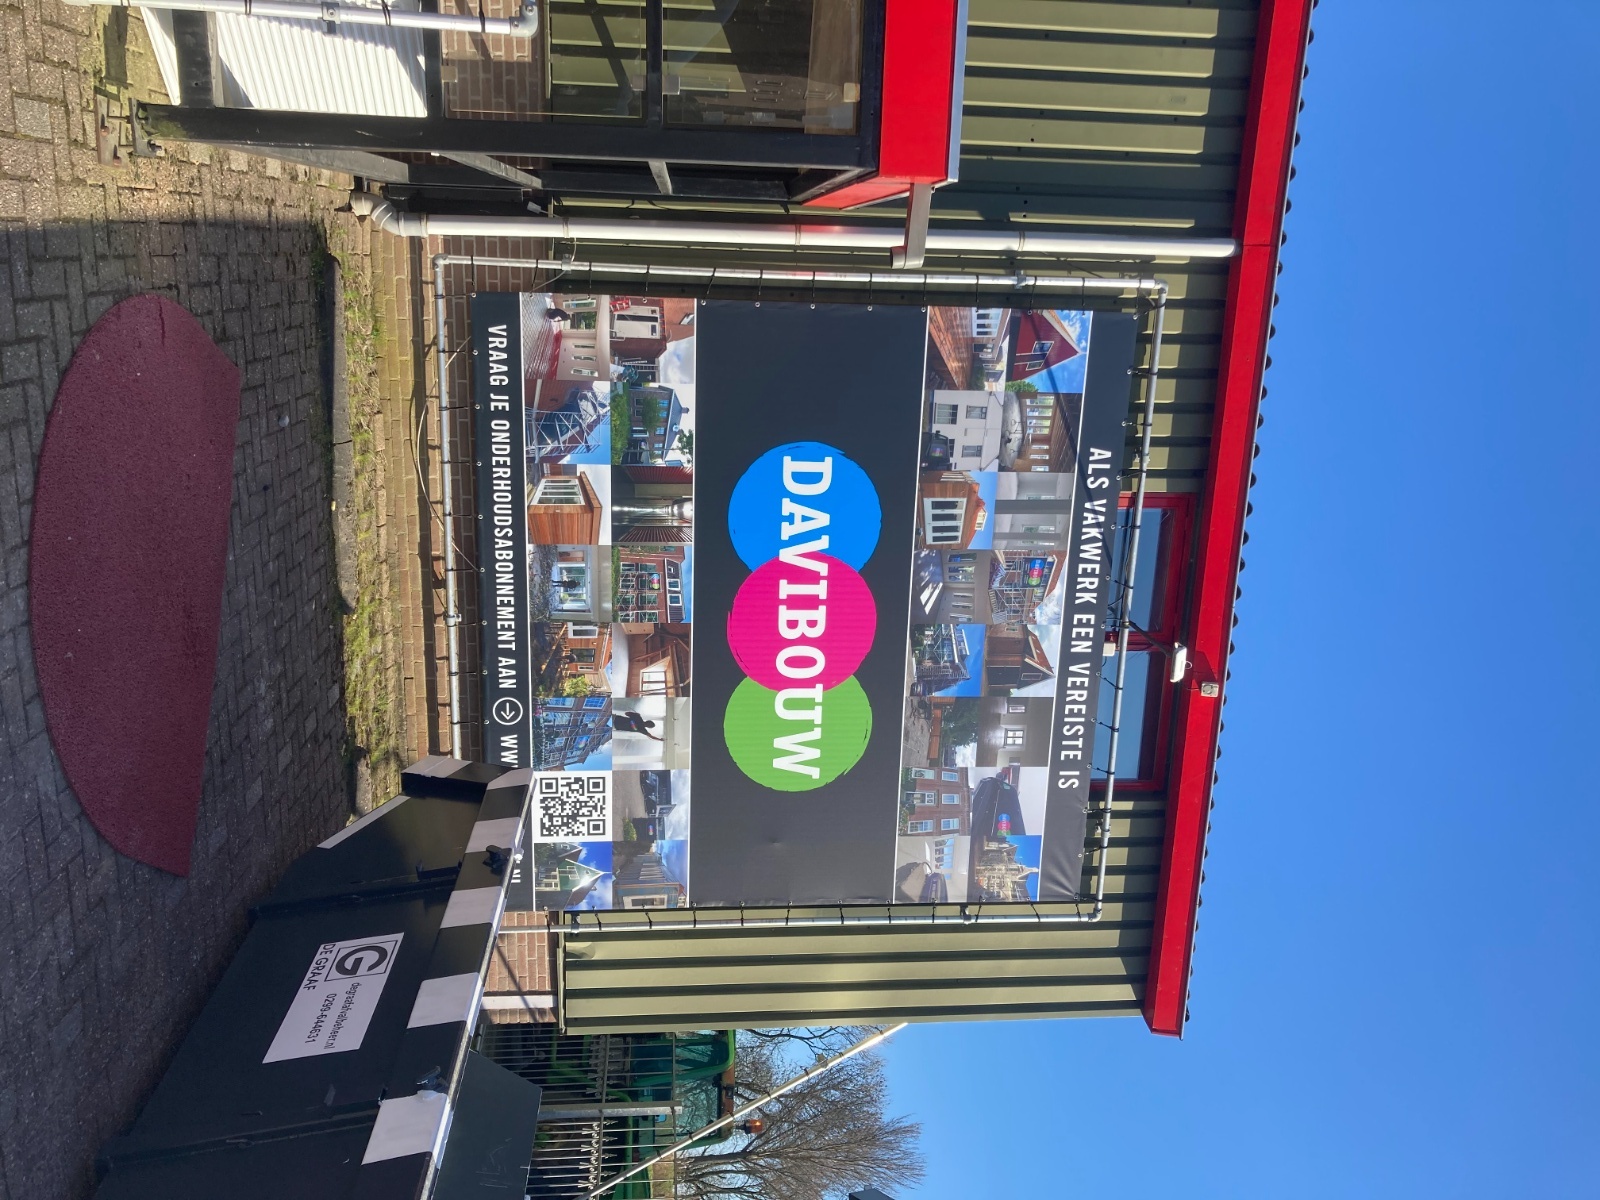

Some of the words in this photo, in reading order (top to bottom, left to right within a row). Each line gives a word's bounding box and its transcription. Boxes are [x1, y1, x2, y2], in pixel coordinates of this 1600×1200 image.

[488, 324, 509, 386] VRAAG
[490, 393, 510, 411] JE
[1087, 447, 1112, 489] ALS
[491, 420, 516, 650] ONDERHOUDSABONNEMENT
[1074, 499, 1107, 604] VAKWERK
[773, 455, 833, 779] DAVIBOUW
[1070, 614, 1095, 652] EEN
[498, 656, 517, 688] AAN
[1060, 663, 1091, 761] VEREISTE
[1058, 771, 1080, 789] IS
[320, 943, 336, 954] DE
[303, 958, 328, 990] GRAAF
[305, 993, 337, 1043] 0299-644631
[324, 982, 362, 1049] degraafafvalbeheer.nl
